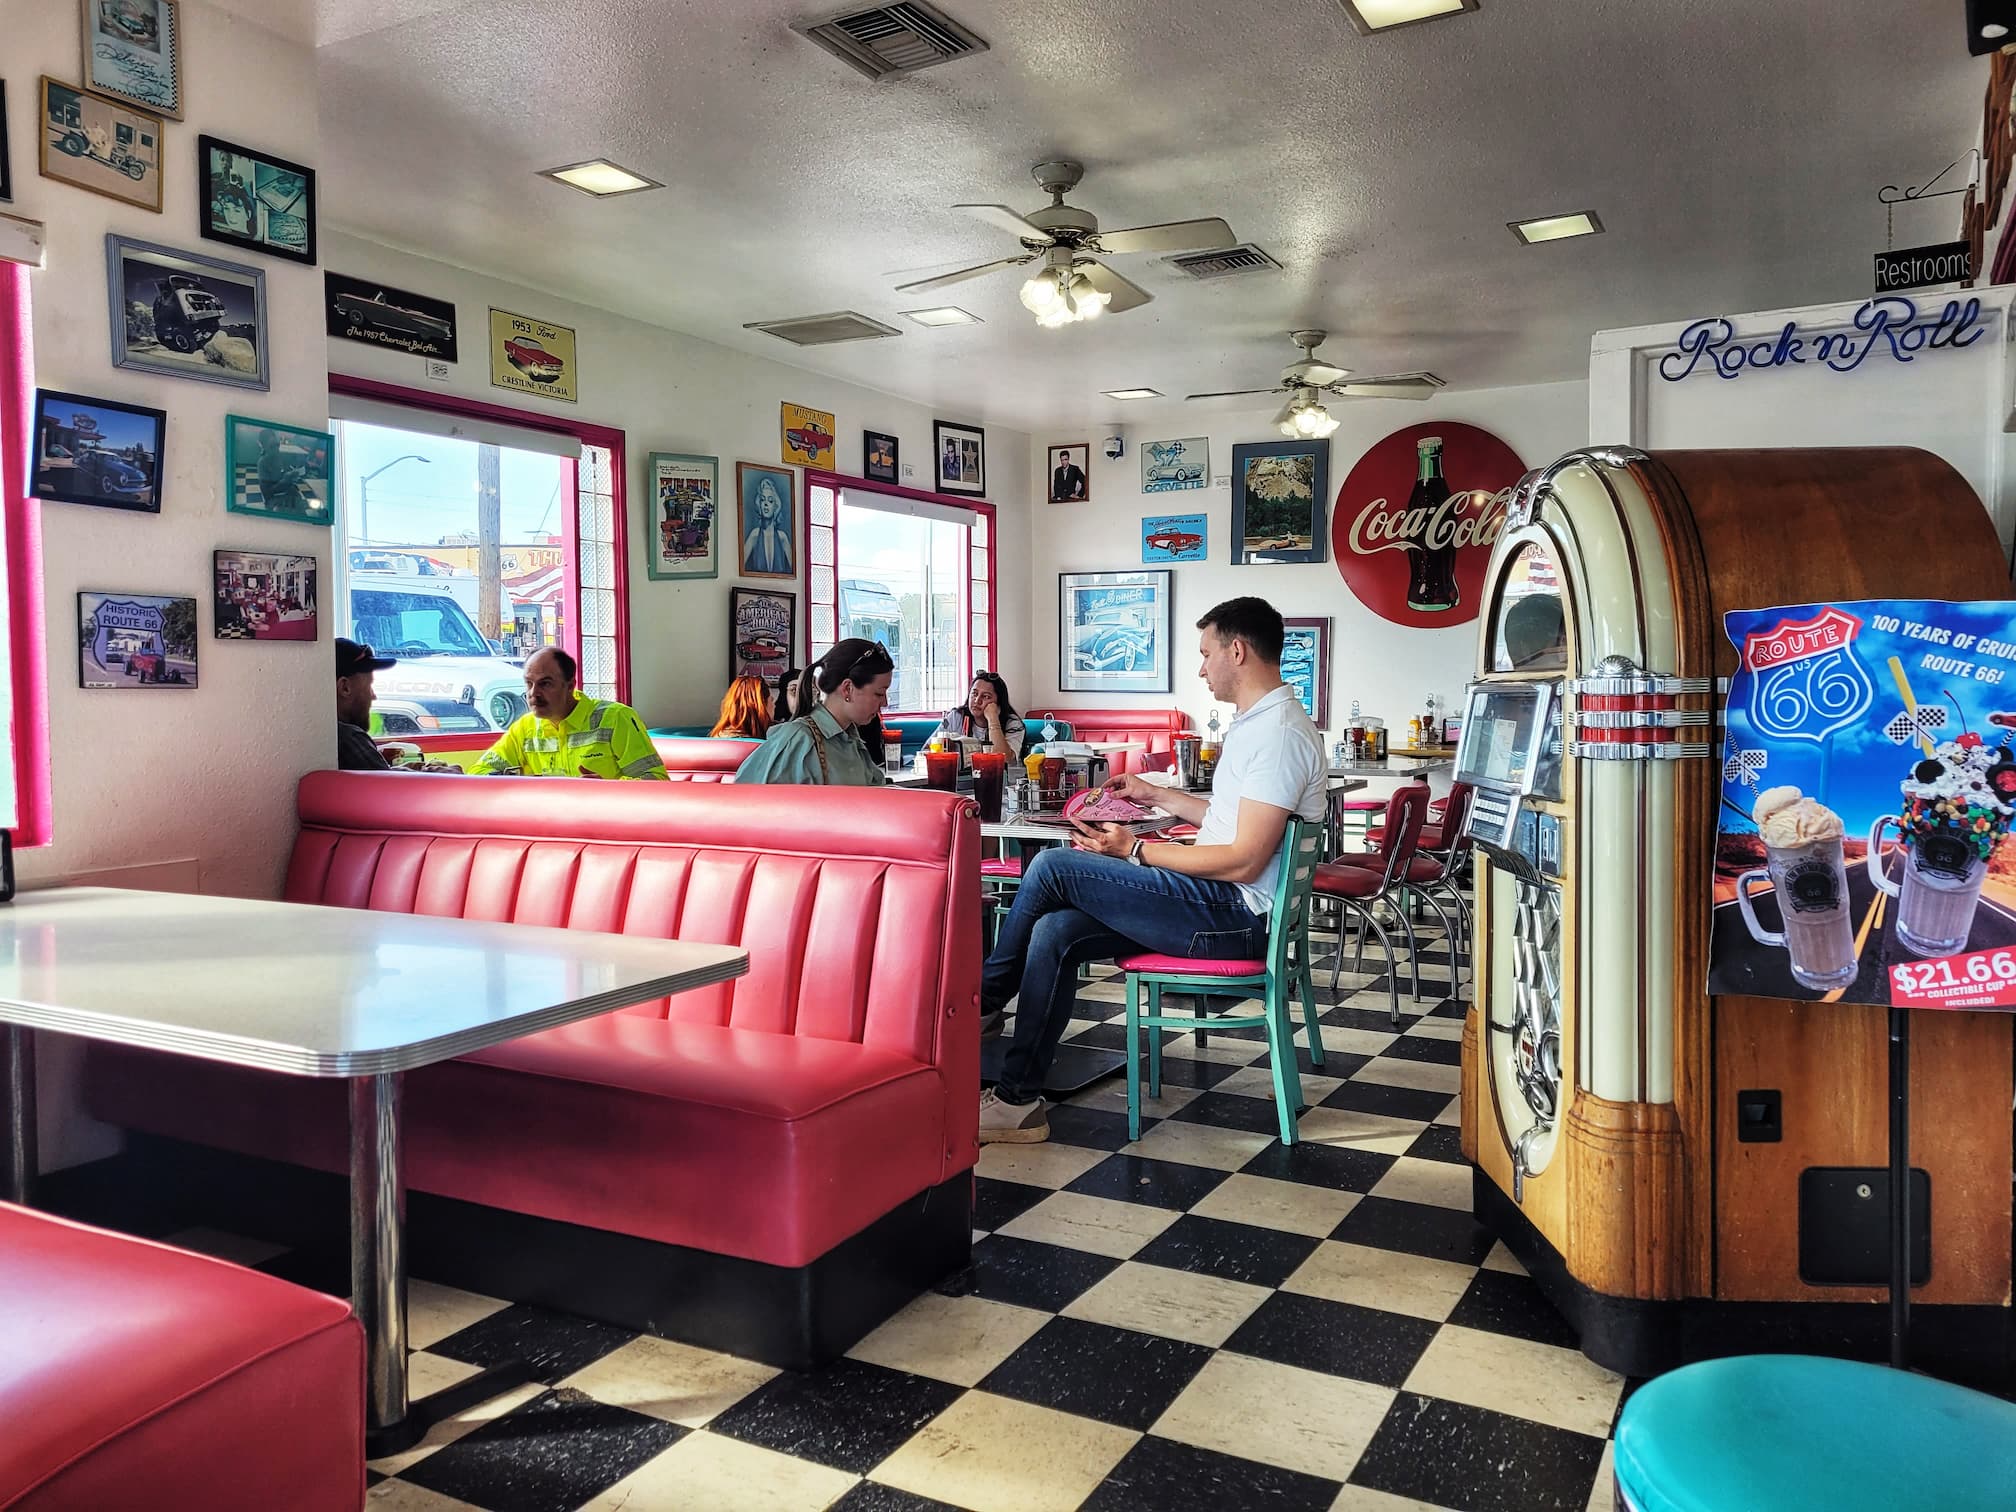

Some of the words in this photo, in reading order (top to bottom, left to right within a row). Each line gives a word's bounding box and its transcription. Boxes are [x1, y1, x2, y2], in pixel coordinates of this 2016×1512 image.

[1875, 252, 1971, 288] Restrooms
[346, 326, 362, 337] The
[363, 329, 379, 340] 1957
[511, 319, 531, 334] 1953
[536, 326, 557, 340] Ford
[1827, 297, 1985, 372] Roll
[1659, 318, 1806, 382] Rock
[1812, 333, 1856, 361] n
[502, 375, 536, 389] CRESTLINE
[538, 384, 568, 397] VICTORIA
[793, 407, 827, 424] MUSTANG
[1144, 479, 1205, 493] CORVETTE
[501, 561, 516, 570] 66
[106, 604, 157, 618] HISTORIC
[739, 607, 788, 623] AMERICAN
[103, 615, 142, 627] ROUTE
[144, 619, 158, 629] 66
[1871, 614, 1901, 633] 100
[1901, 621, 1952, 645] YEARS
[1952, 633, 1977, 650] OF
[1756, 624, 1840, 664] ROUTE
[1794, 659, 1812, 672] US
[1920, 653, 1975, 678] ROUTE
[1974, 666, 2006, 685] 66!
[1761, 652, 1860, 730] 66
[1893, 951, 2016, 994] $21.66
[1927, 983, 1984, 999] COLLECTIBLE
[1985, 980, 2005, 993] CUP
[1944, 996, 1995, 1007] INCLUDED!
